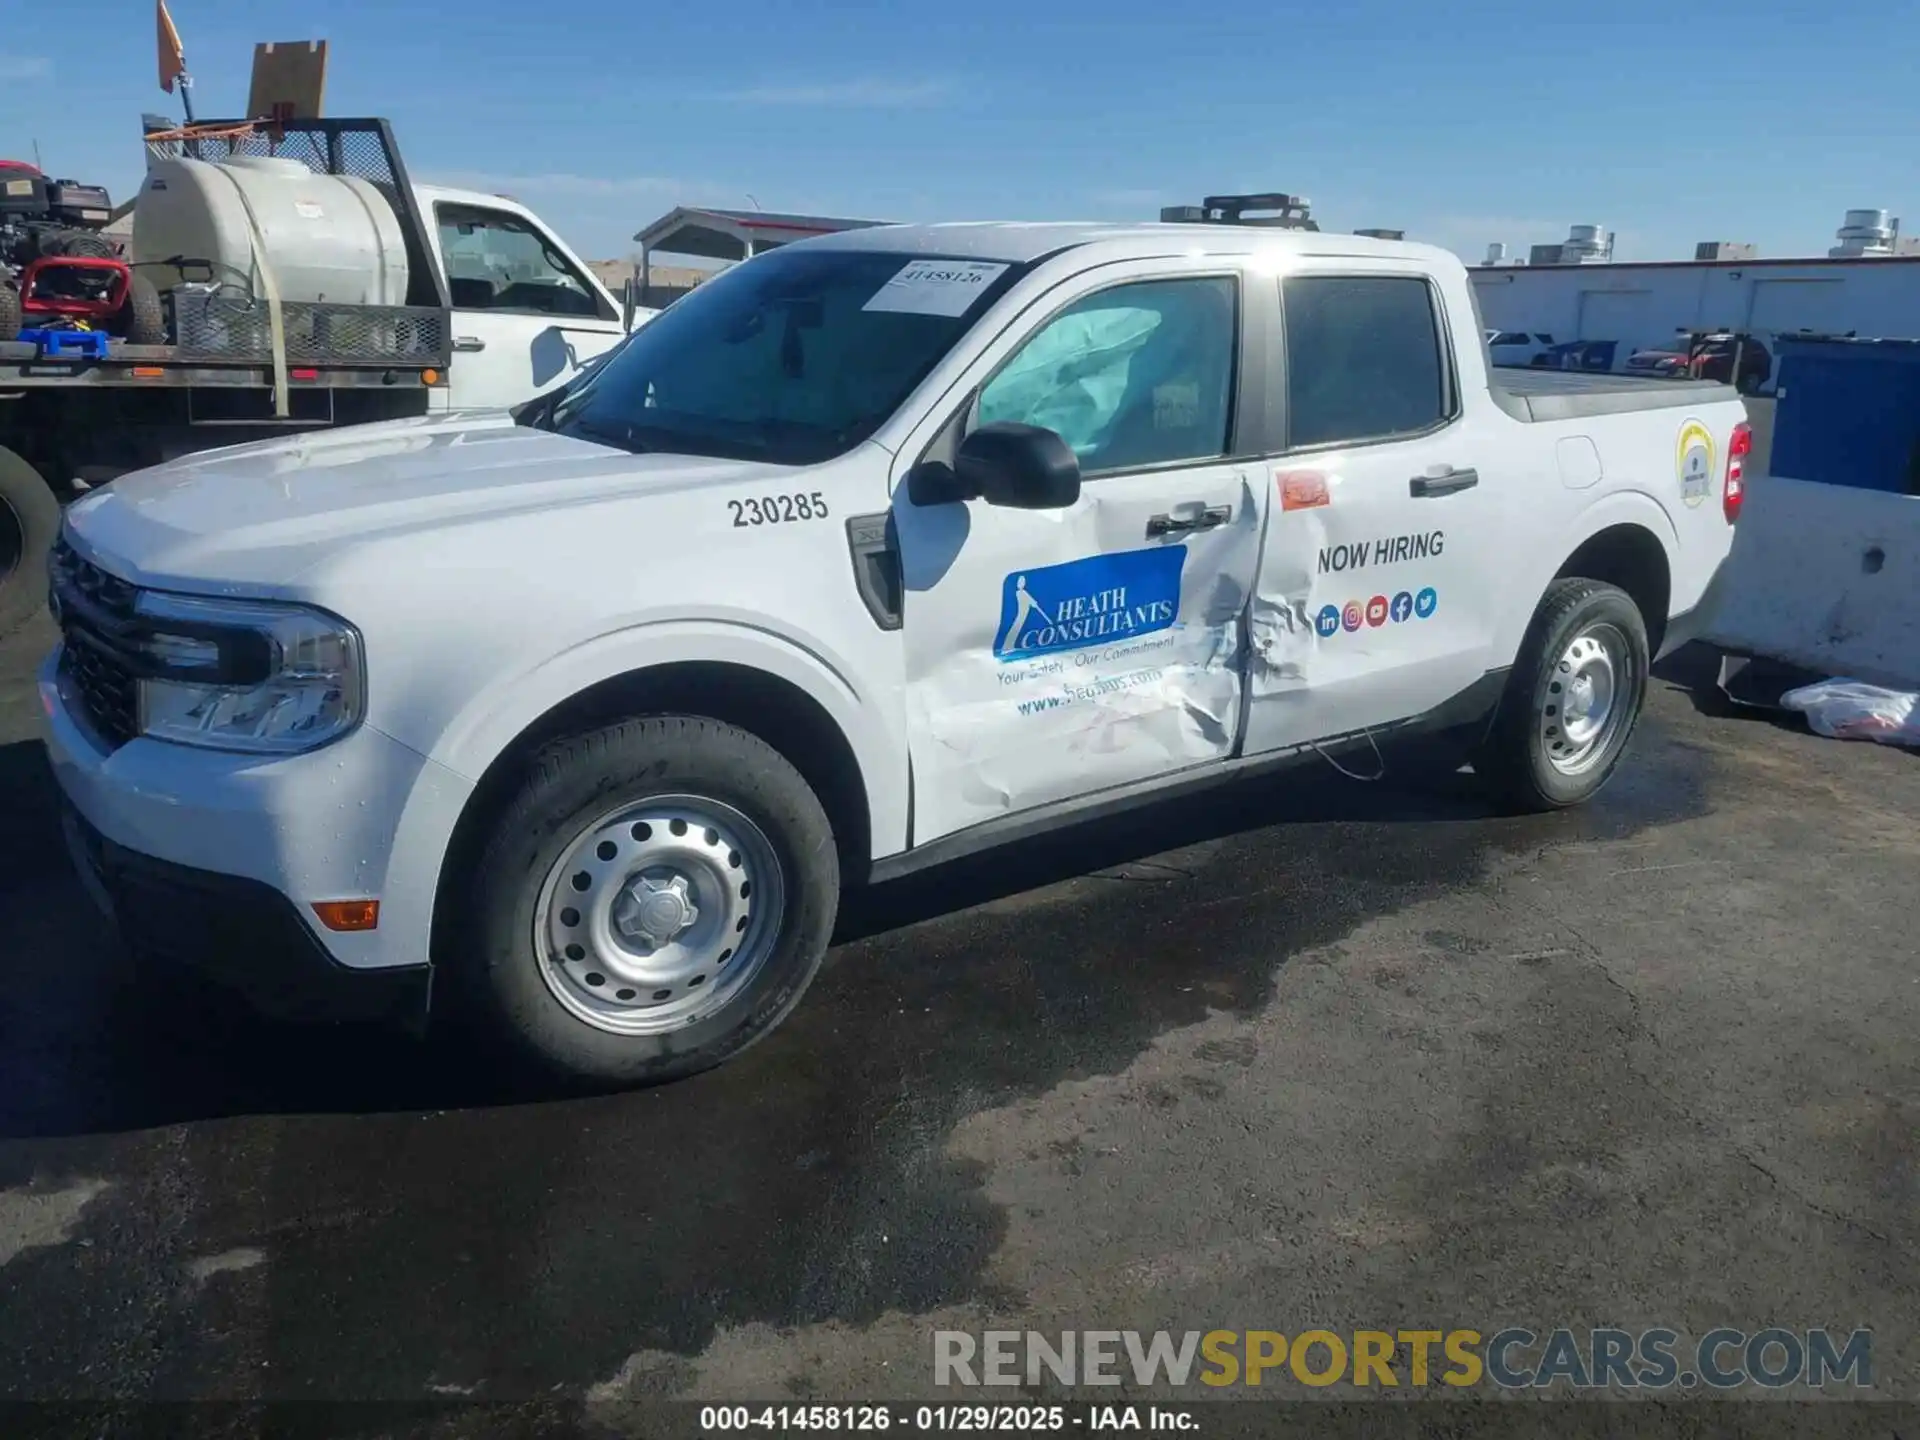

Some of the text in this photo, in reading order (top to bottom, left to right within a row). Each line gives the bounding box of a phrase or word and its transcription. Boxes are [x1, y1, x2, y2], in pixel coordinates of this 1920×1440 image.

[728, 492, 828, 527] 230285
[1318, 531, 1444, 574] NOW HIRING
[1057, 587, 1126, 622] HEATH
[1021, 601, 1172, 649] CONSULTANTS
[996, 671, 1025, 687] Your
[1074, 652, 1099, 668] Our
